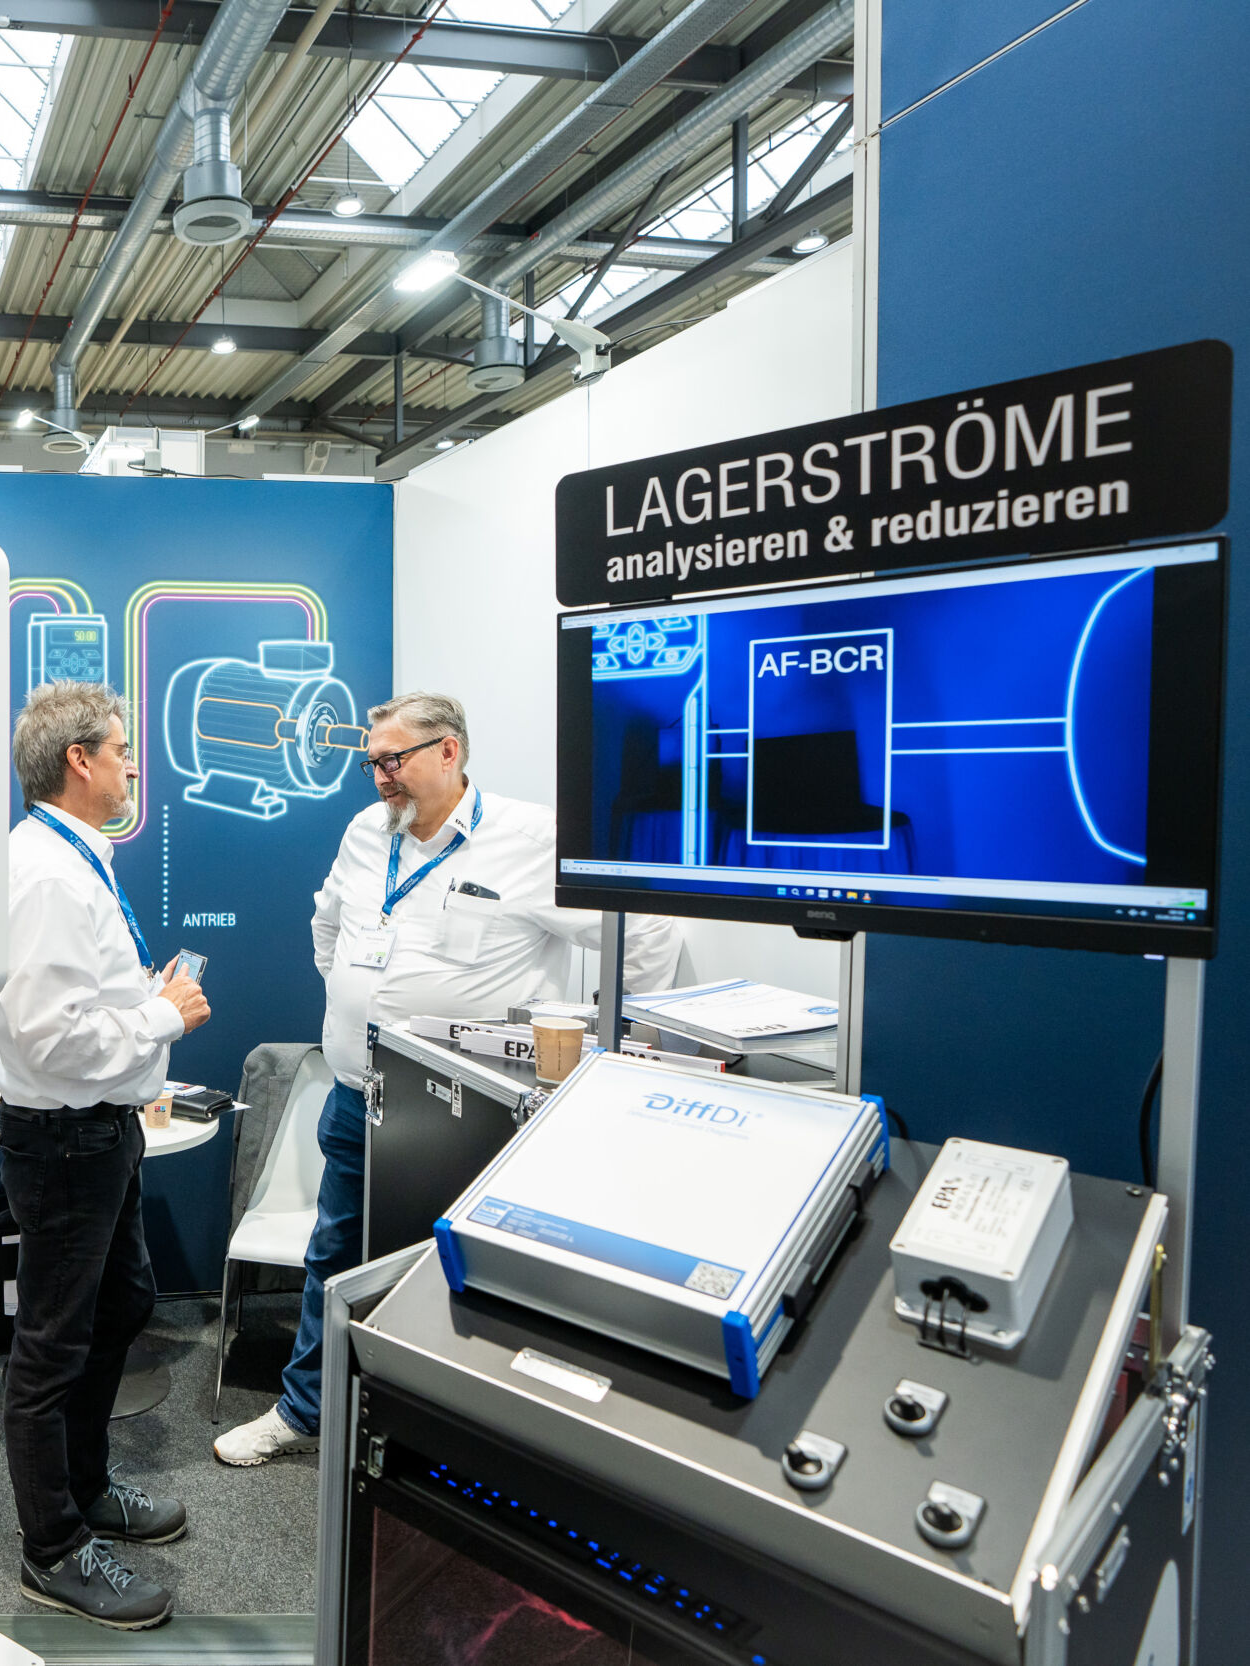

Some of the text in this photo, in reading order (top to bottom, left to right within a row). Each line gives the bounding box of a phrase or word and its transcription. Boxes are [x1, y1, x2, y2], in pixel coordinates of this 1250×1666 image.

[605, 382, 1134, 537] LAGERSTRÖME
[606, 479, 1129, 583] analysieren & reduzieren
[757, 645, 884, 678] AF-BCR
[182, 913, 236, 927] ANTRIEB
